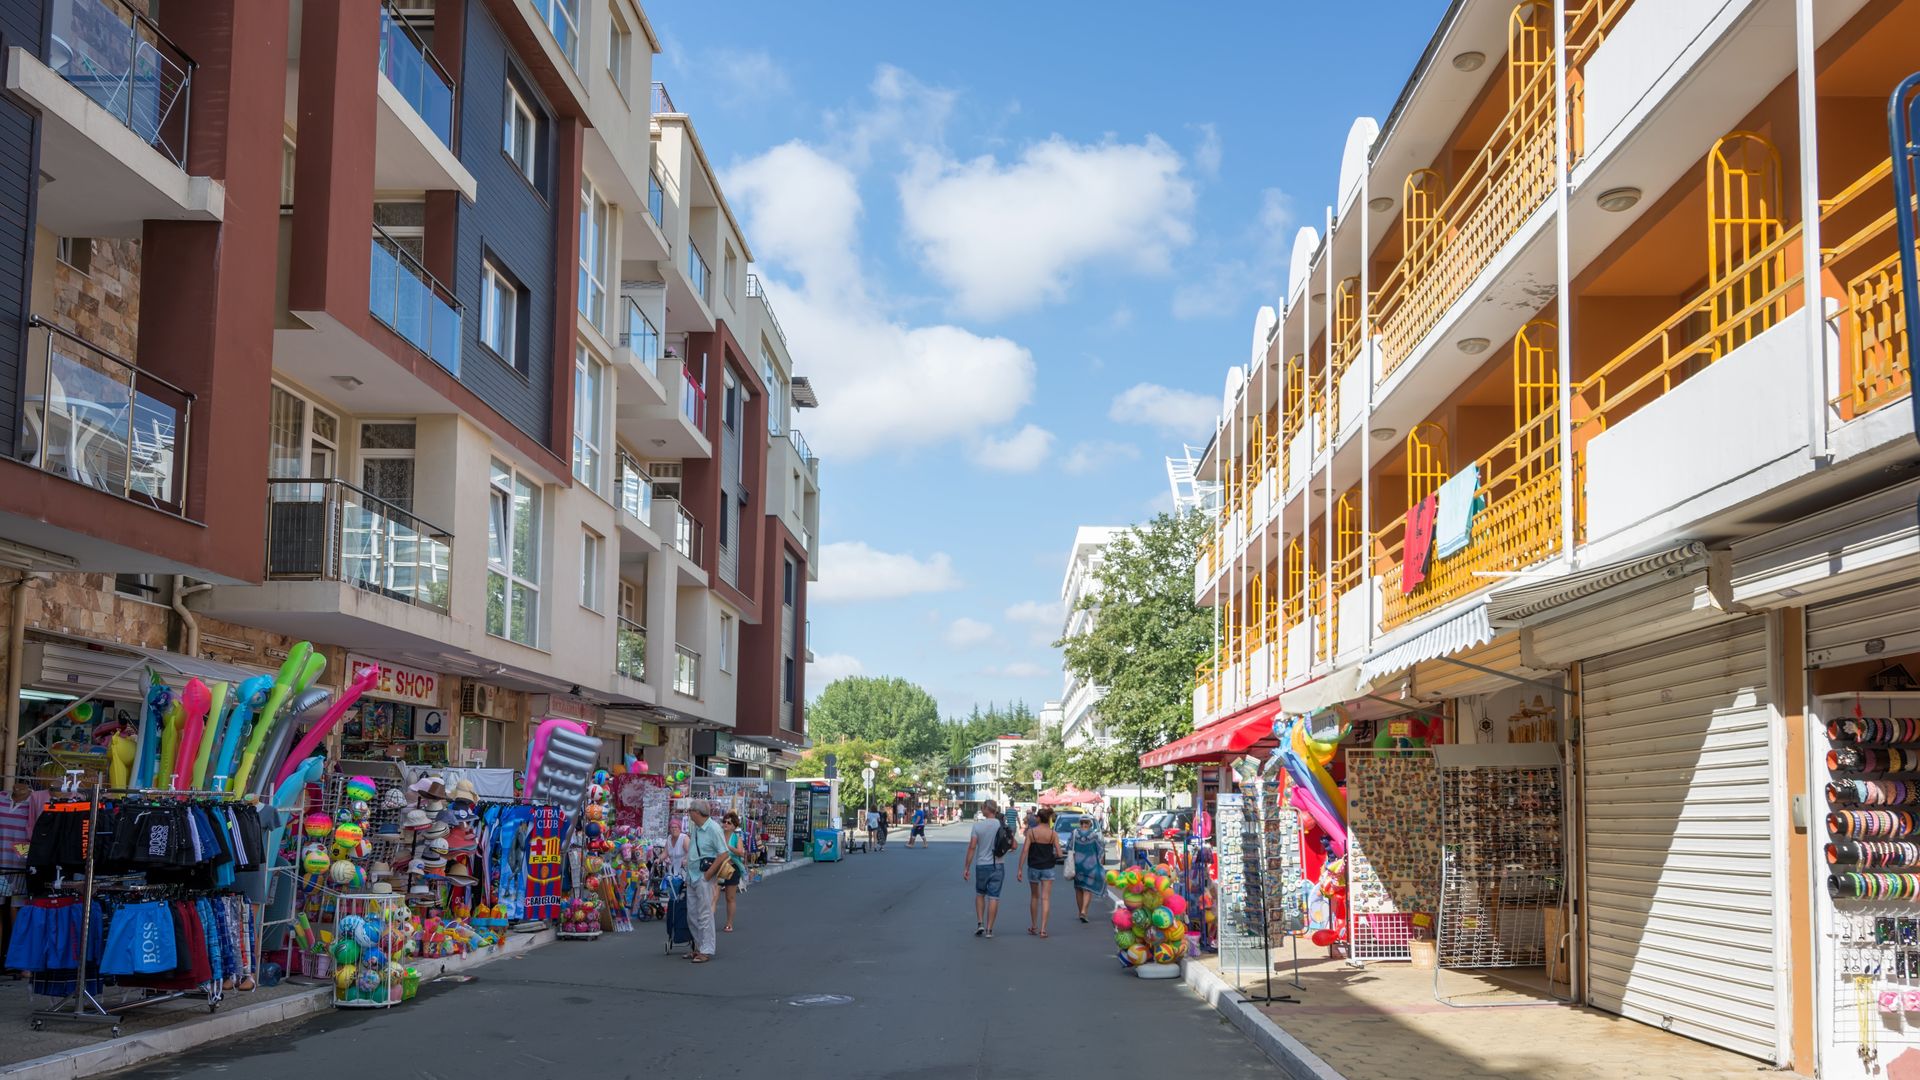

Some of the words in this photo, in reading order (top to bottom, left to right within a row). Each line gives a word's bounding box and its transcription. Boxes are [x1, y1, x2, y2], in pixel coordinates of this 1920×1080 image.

[352, 661, 391, 692] FE
[396, 670, 434, 699] SHOP
[149, 825, 163, 855] BOSS
[537, 819, 559, 829] CLUB
[142, 921, 157, 964] BOSS
